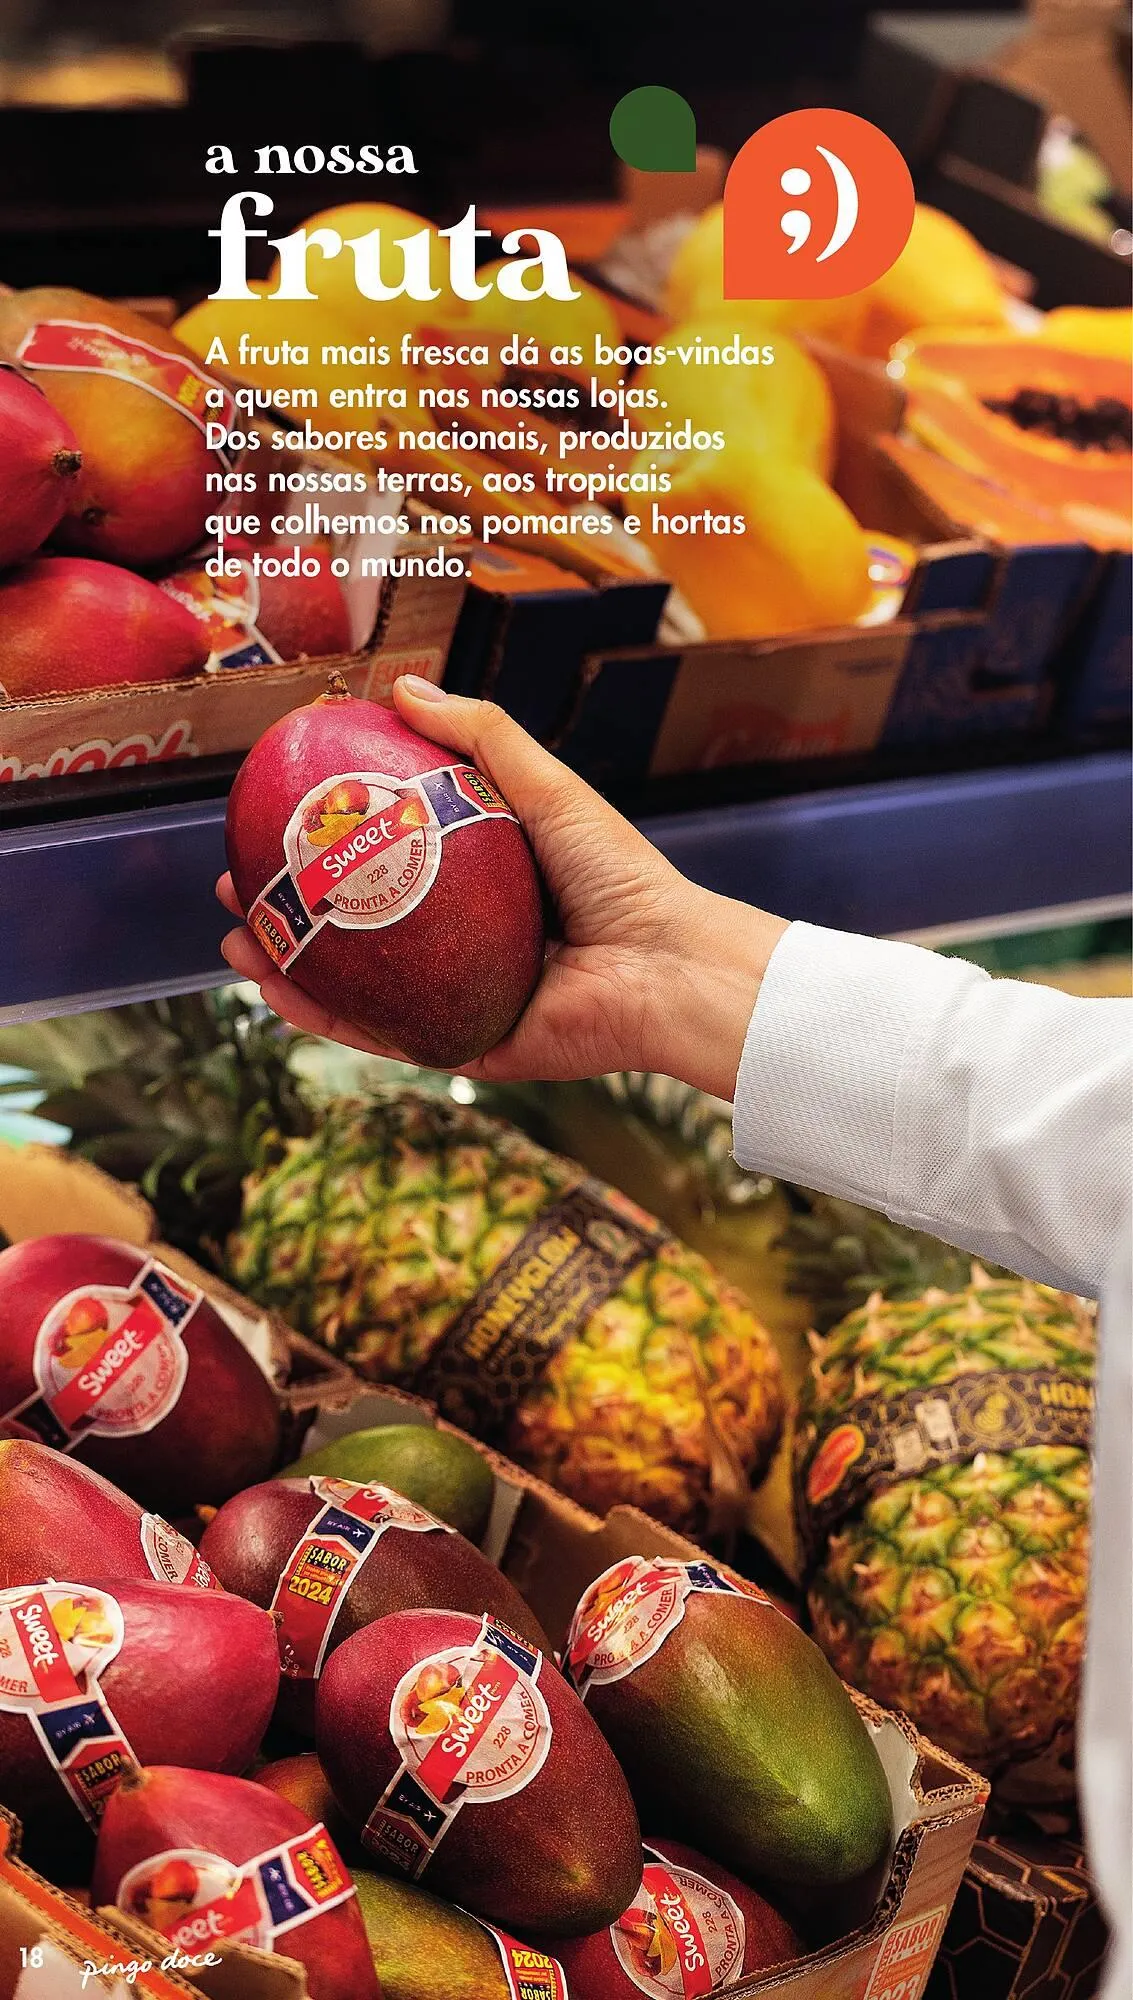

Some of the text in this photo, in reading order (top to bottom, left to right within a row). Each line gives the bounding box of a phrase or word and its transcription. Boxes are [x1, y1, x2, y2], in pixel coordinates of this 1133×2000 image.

[322, 817, 397, 879] Sweet
[335, 838, 424, 911] PRONTA A COMER
[366, 864, 389, 885] 228
[261, 917, 288, 952] SABOR
[78, 1328, 145, 1397] Sweet
[310, 1547, 348, 1571] SABOR
[288, 1575, 334, 1606] 2024
[587, 1580, 649, 1642] Sweet
[16, 1604, 60, 1669] Sweet
[639, 1630, 649, 1642] A
[647, 1588, 673, 1630] COMER
[441, 1683, 502, 1758] Sweet
[493, 1725, 512, 1749] 228
[466, 1754, 522, 1783] PRONTA
[517, 1743, 530, 1755] A
[385, 1825, 419, 1854] SABOR
[661, 1893, 705, 1972] Sweet
[679, 1876, 738, 1978] PRONTA A COMER
[702, 1911, 719, 1934] 228
[511, 1948, 554, 1969] 2024
